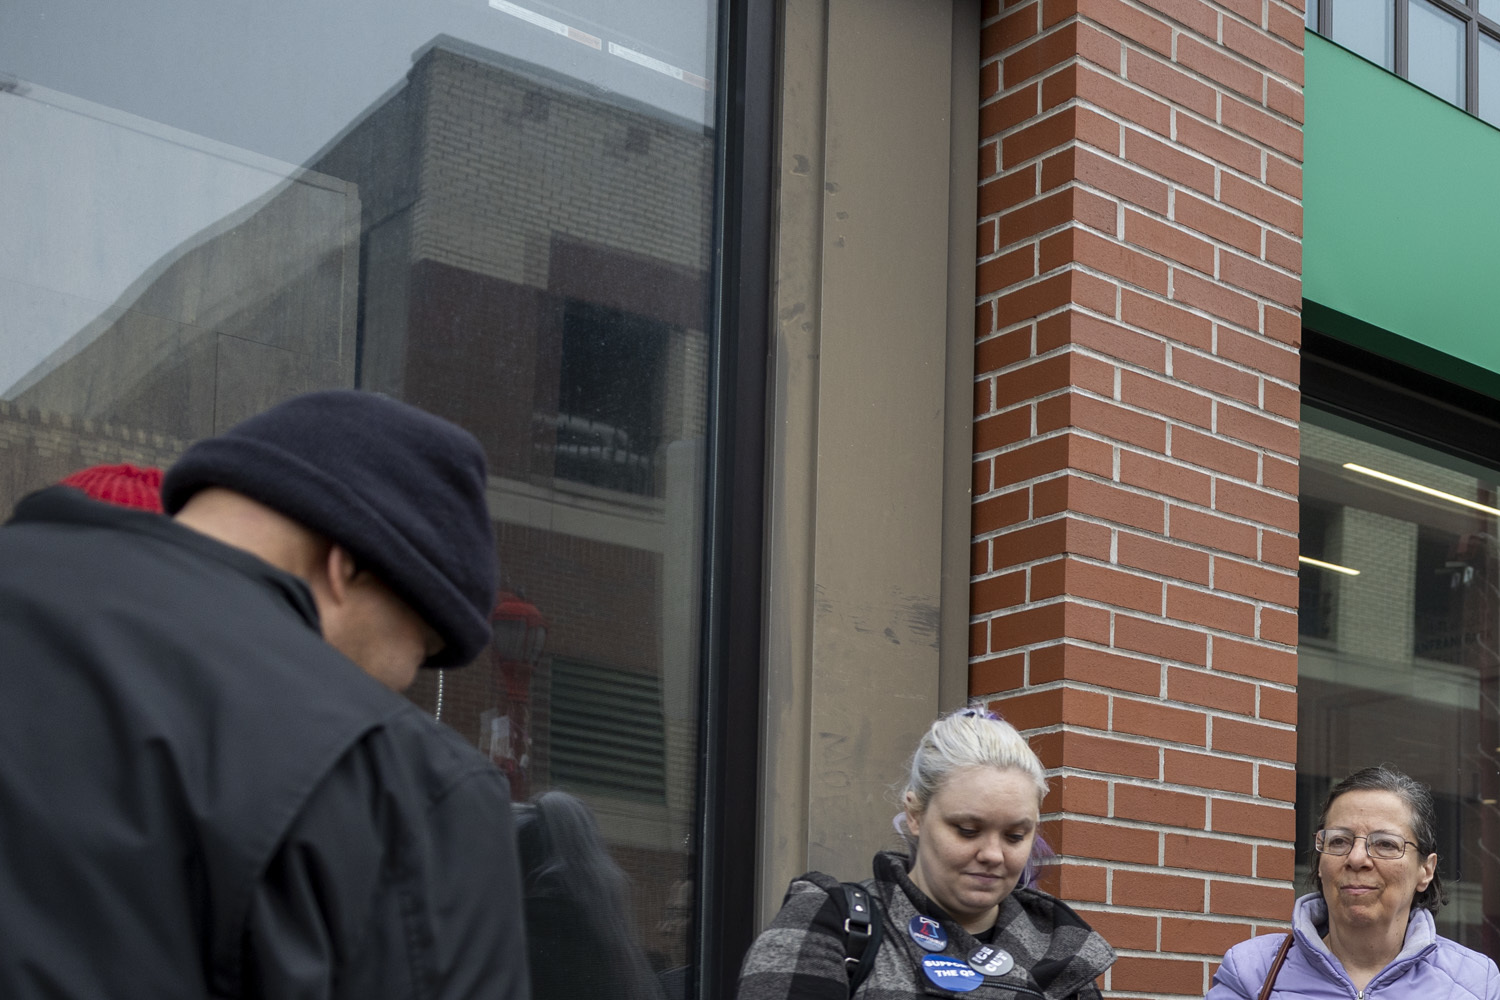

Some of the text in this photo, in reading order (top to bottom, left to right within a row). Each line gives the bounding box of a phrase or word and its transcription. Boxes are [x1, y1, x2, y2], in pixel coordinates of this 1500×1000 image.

[971, 946, 994, 964] ICE
[984, 951, 1008, 973] OUT
[934, 969, 959, 977] THE
